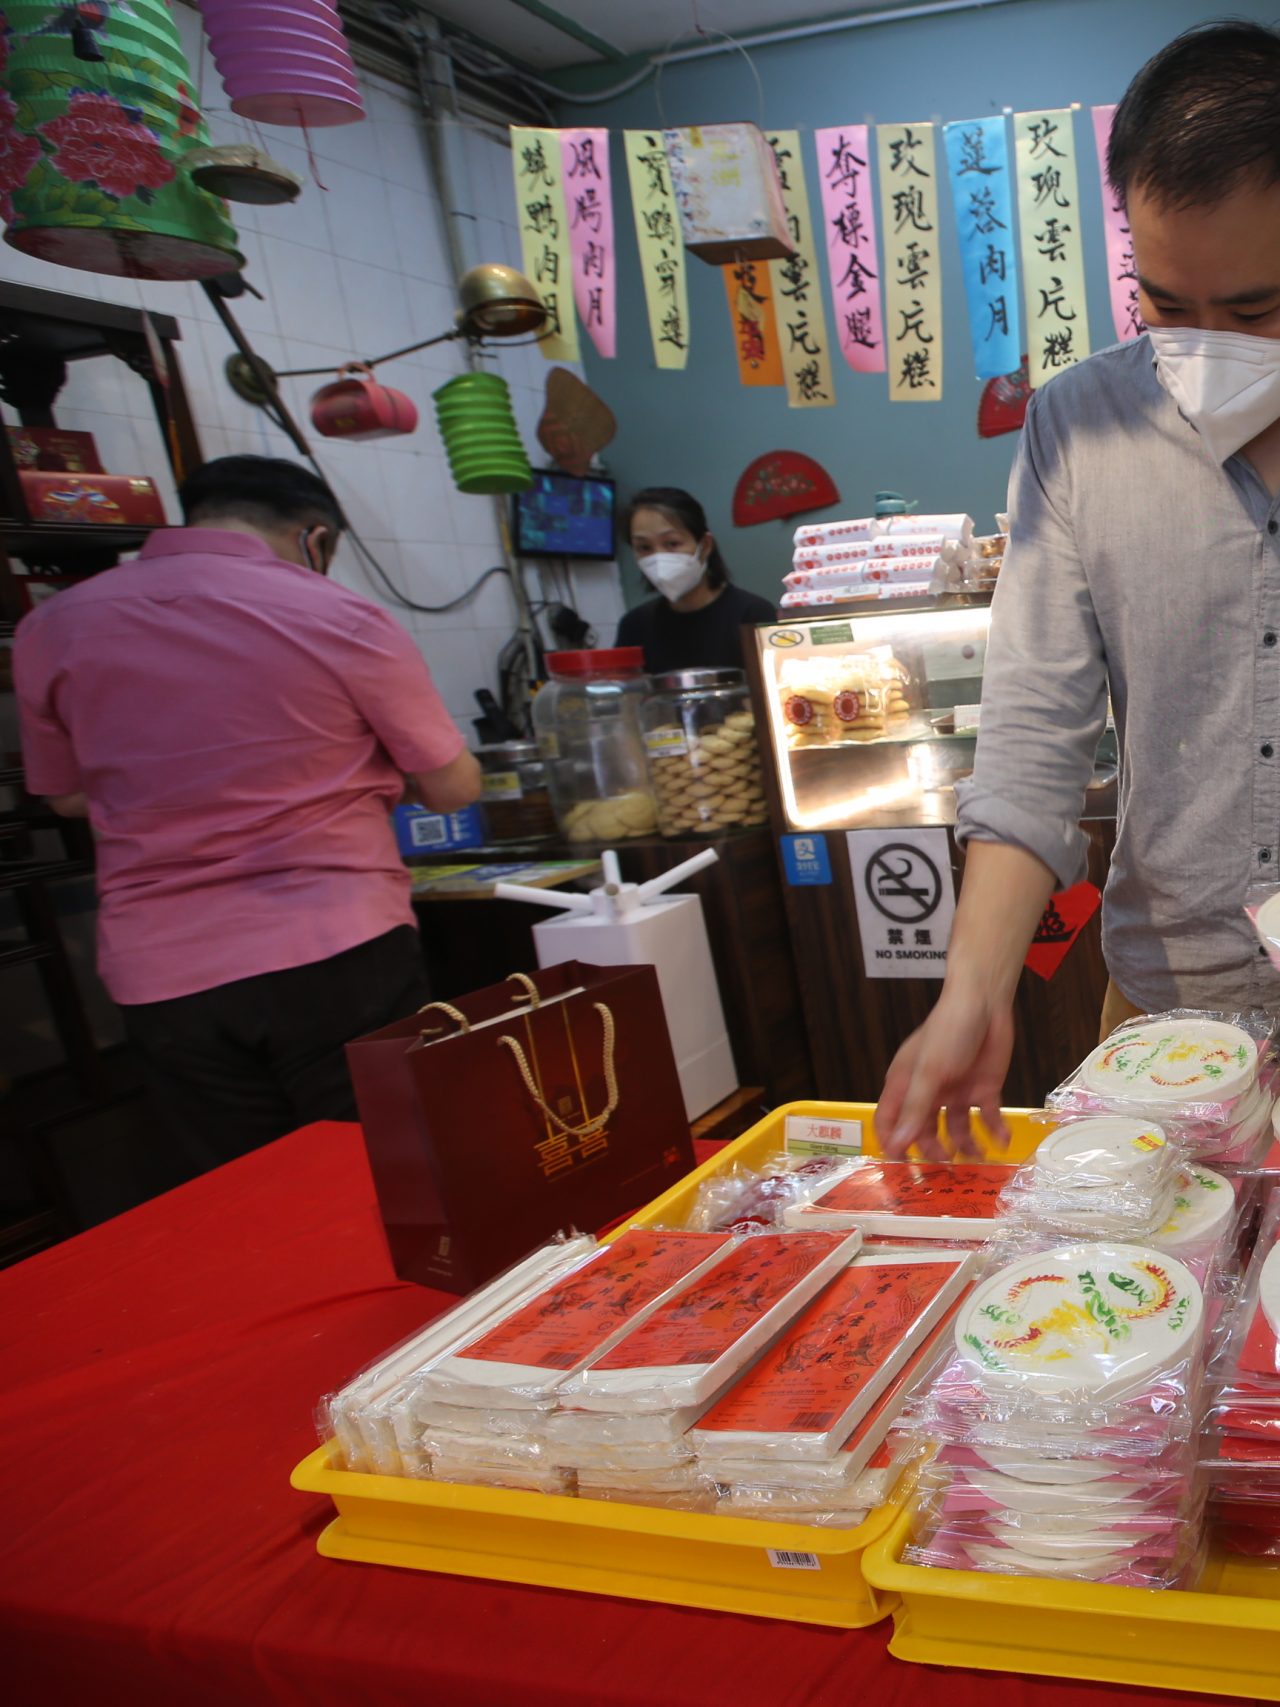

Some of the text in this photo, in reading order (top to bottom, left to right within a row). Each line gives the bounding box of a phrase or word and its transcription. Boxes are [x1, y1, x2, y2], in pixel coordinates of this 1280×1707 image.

[956, 126, 1009, 342] 蓮蓉肉月
[876, 951, 892, 960] NO
